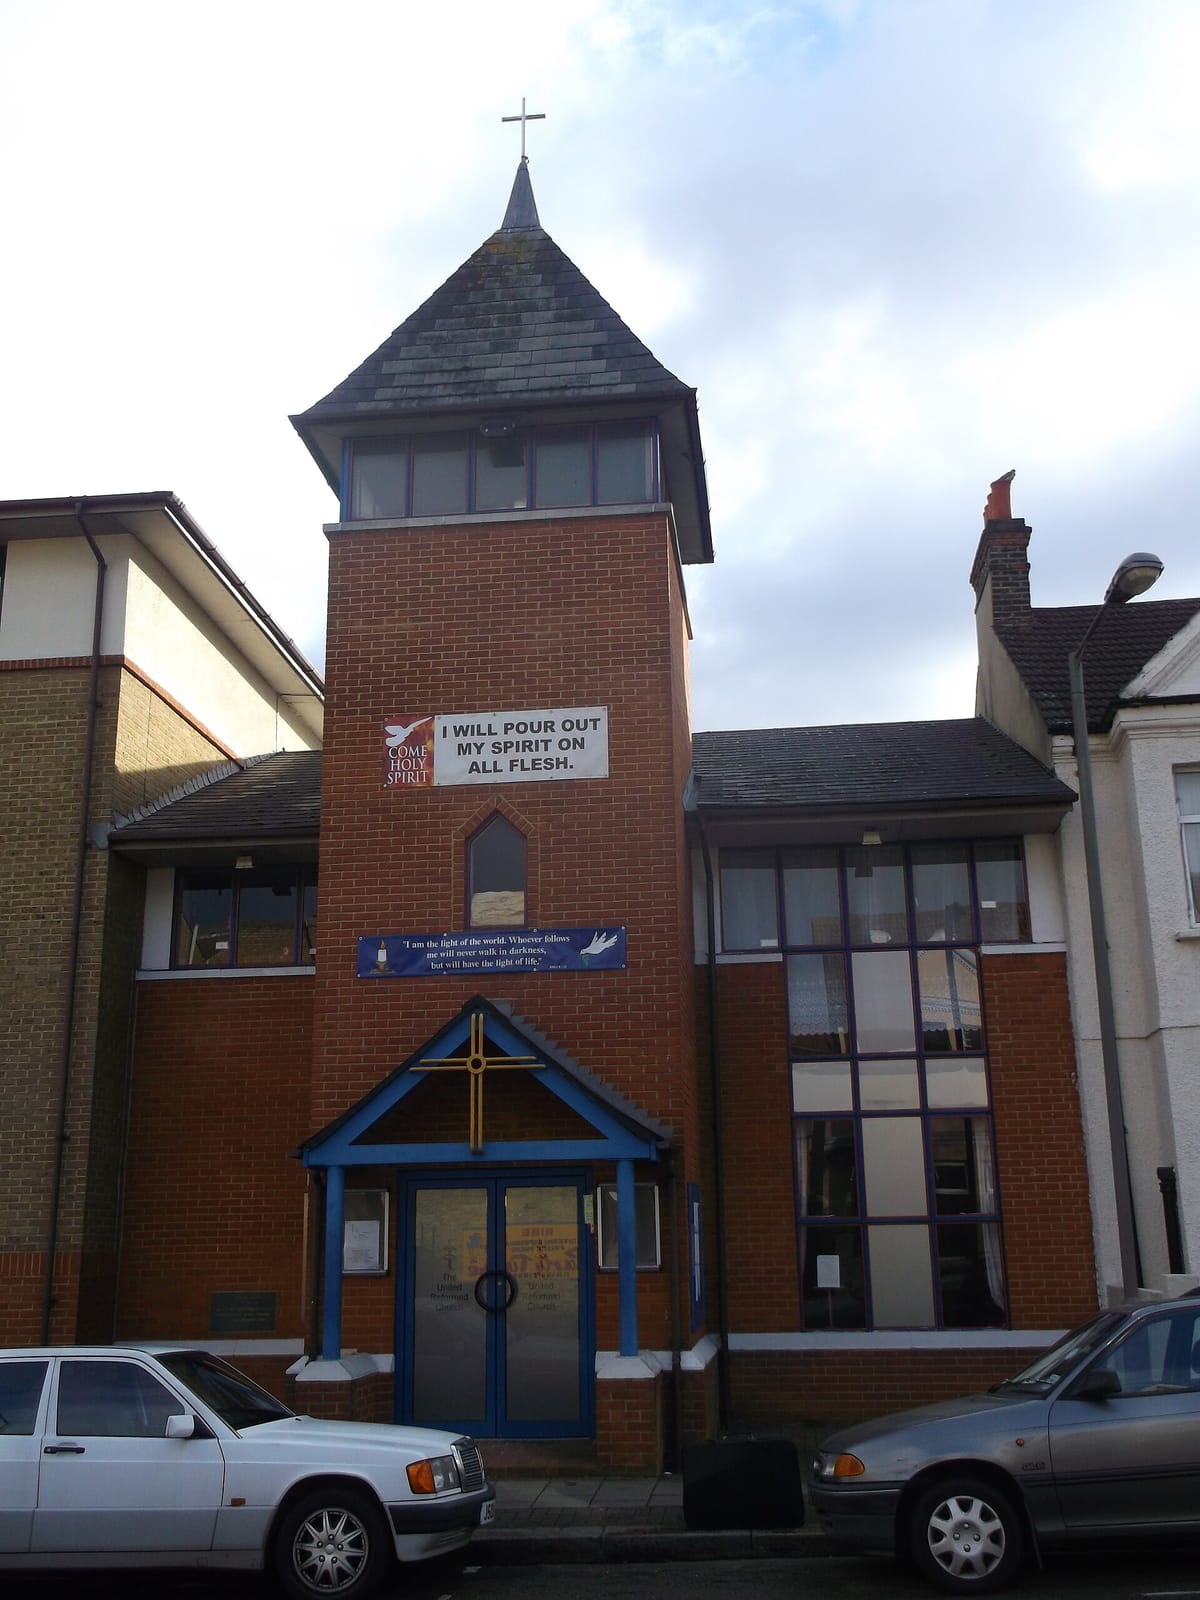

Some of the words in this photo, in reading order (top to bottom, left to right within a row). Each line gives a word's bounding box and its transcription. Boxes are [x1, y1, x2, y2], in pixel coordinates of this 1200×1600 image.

[442, 725, 447, 738] I
[453, 723, 498, 737] WILL
[503, 720, 556, 735] POUR
[561, 718, 601, 732] OUT
[388, 745, 428, 759] COME
[457, 742, 485, 756] MY
[491, 739, 552, 755] SPIRIT
[558, 737, 585, 751] ON
[390, 758, 426, 771] HOLY
[468, 760, 503, 774] ALL
[509, 756, 574, 772] FLESH.
[387, 770, 429, 785] SPIRIT
[426, 940, 439, 948] the
[440, 939, 458, 949] light
[460, 938, 468, 946] of
[469, 937, 481, 946] the
[482, 936, 507, 945] world.
[508, 935, 544, 944] Whoever
[544, 934, 570, 943] follows
[439, 949, 455, 959] will
[456, 950, 477, 958] never
[478, 948, 497, 956] walk
[499, 947, 507, 956] in
[509, 946, 547, 955] darkness,
[431, 961, 444, 970] but
[445, 960, 460, 969] will
[462, 960, 479, 968] have
[481, 959, 494, 967] the
[495, 958, 513, 968] light
[515, 957, 524, 966] of
[436, 1282, 462, 1292] United
[430, 1293, 469, 1302] Reformed
